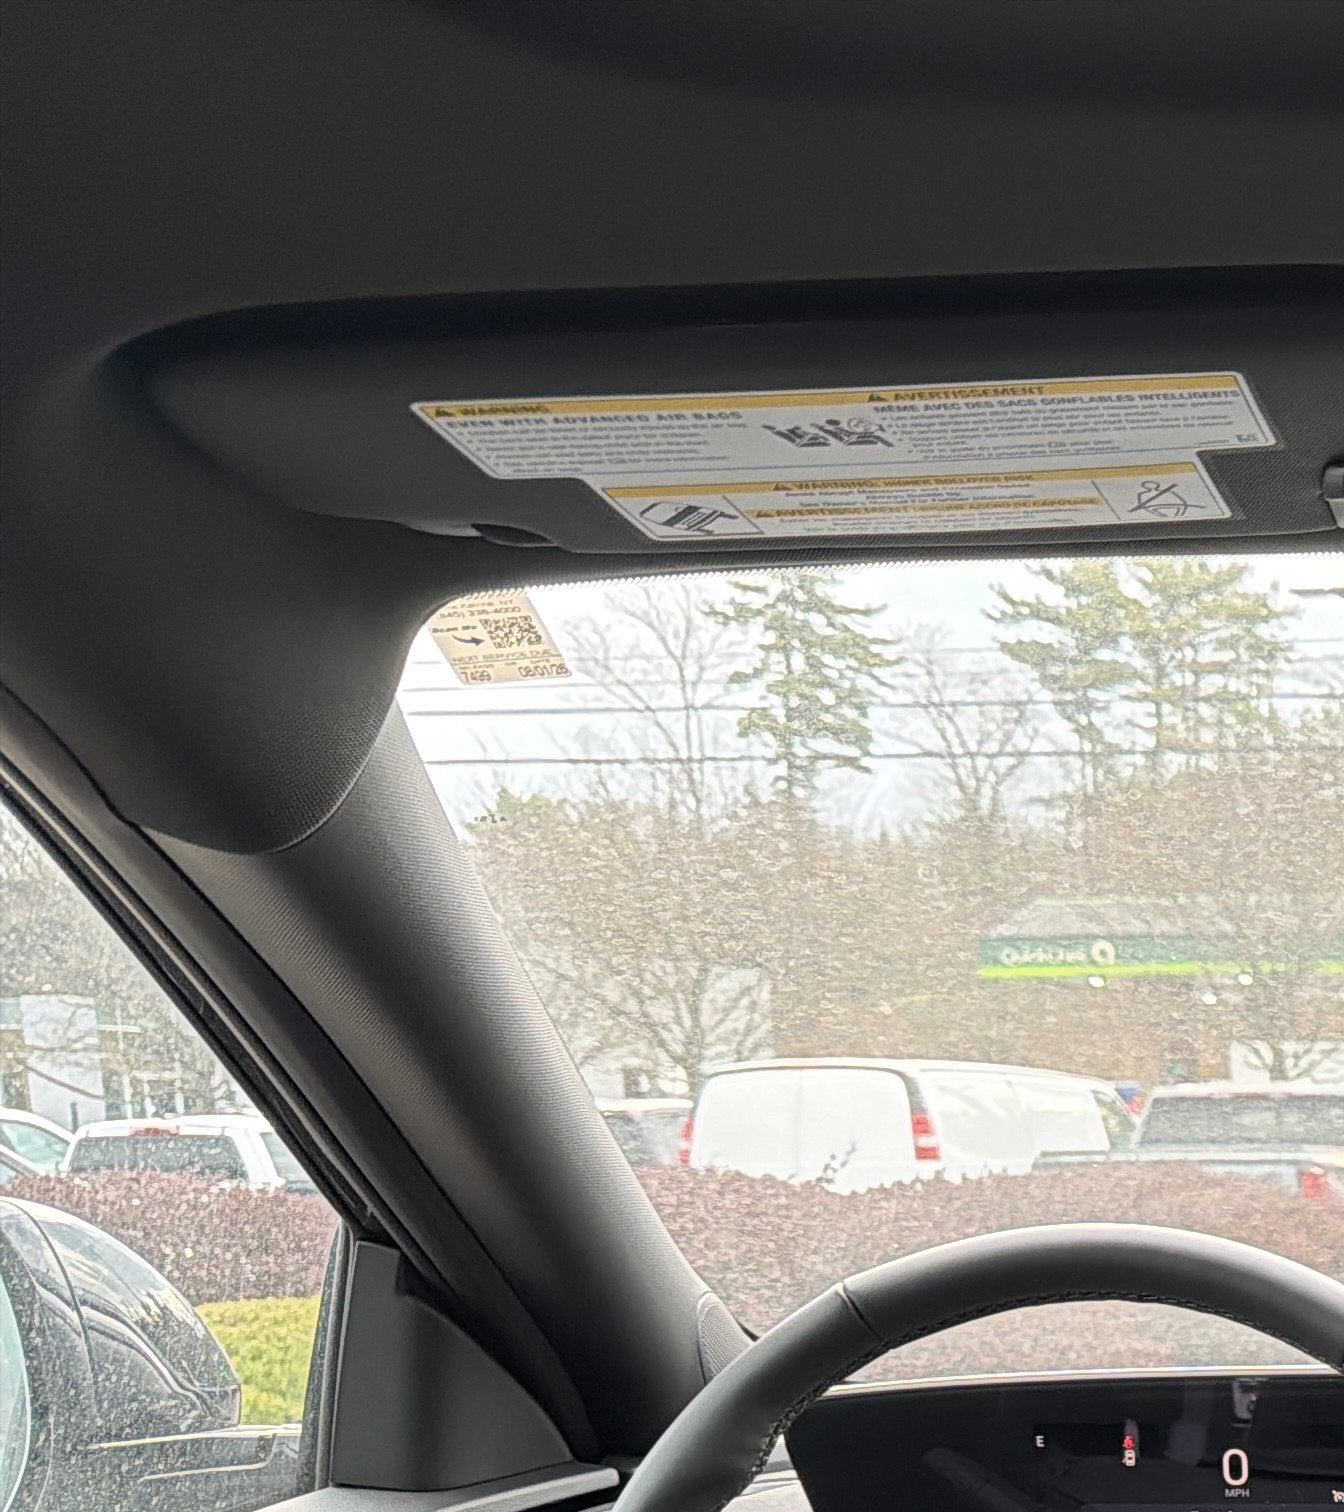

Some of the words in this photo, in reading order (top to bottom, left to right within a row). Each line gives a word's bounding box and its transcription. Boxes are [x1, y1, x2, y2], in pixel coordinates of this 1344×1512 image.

[893, 385, 1045, 402] AVERTISSEMENT
[922, 401, 960, 413] AVEC
[965, 400, 994, 411] DES
[501, 415, 546, 427] WITH
[551, 414, 649, 426] ADVANCED
[656, 412, 690, 423] AIR
[691, 411, 744, 422] BAGS
[1035, 1435, 1045, 1447] E
[1222, 1448, 1249, 1486] 0
[1225, 1489, 1250, 1498] MPH
